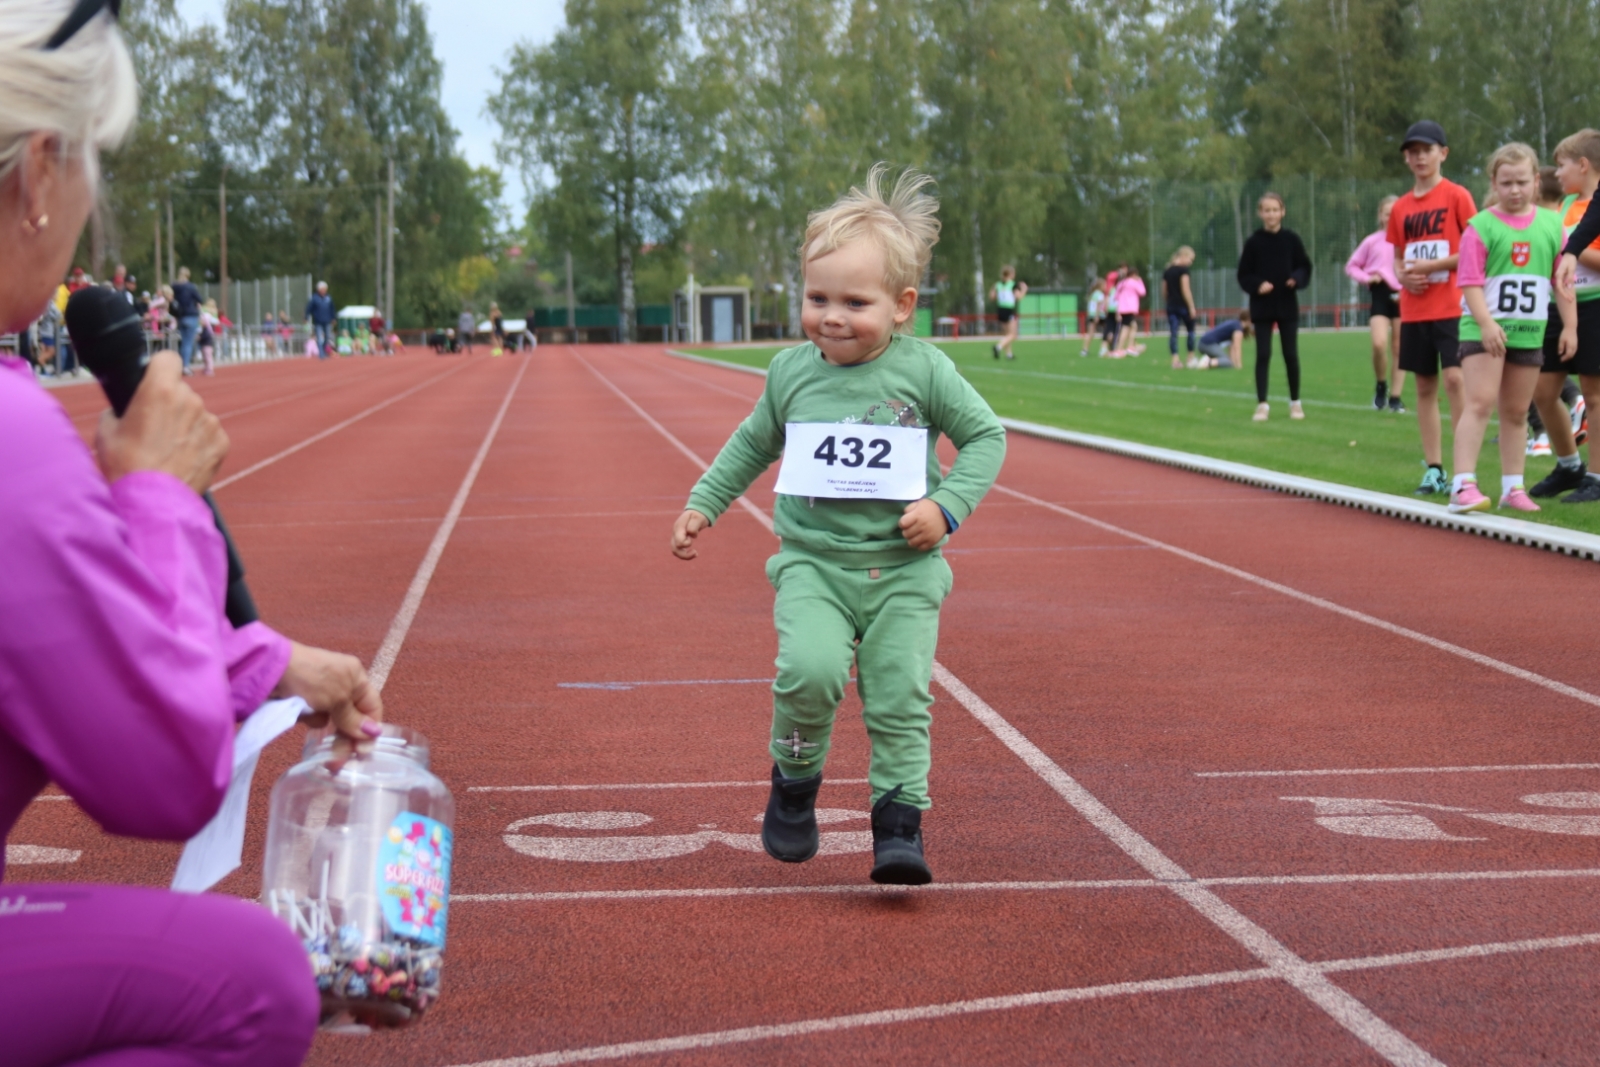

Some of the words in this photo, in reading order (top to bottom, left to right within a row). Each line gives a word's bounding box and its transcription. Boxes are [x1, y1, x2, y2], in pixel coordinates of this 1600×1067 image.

[1404, 208, 1448, 240] NIKE
[1412, 242, 1439, 260] 104
[1498, 280, 1537, 313] 65
[814, 435, 891, 469] 432
[385, 863, 426, 886] SUPER
